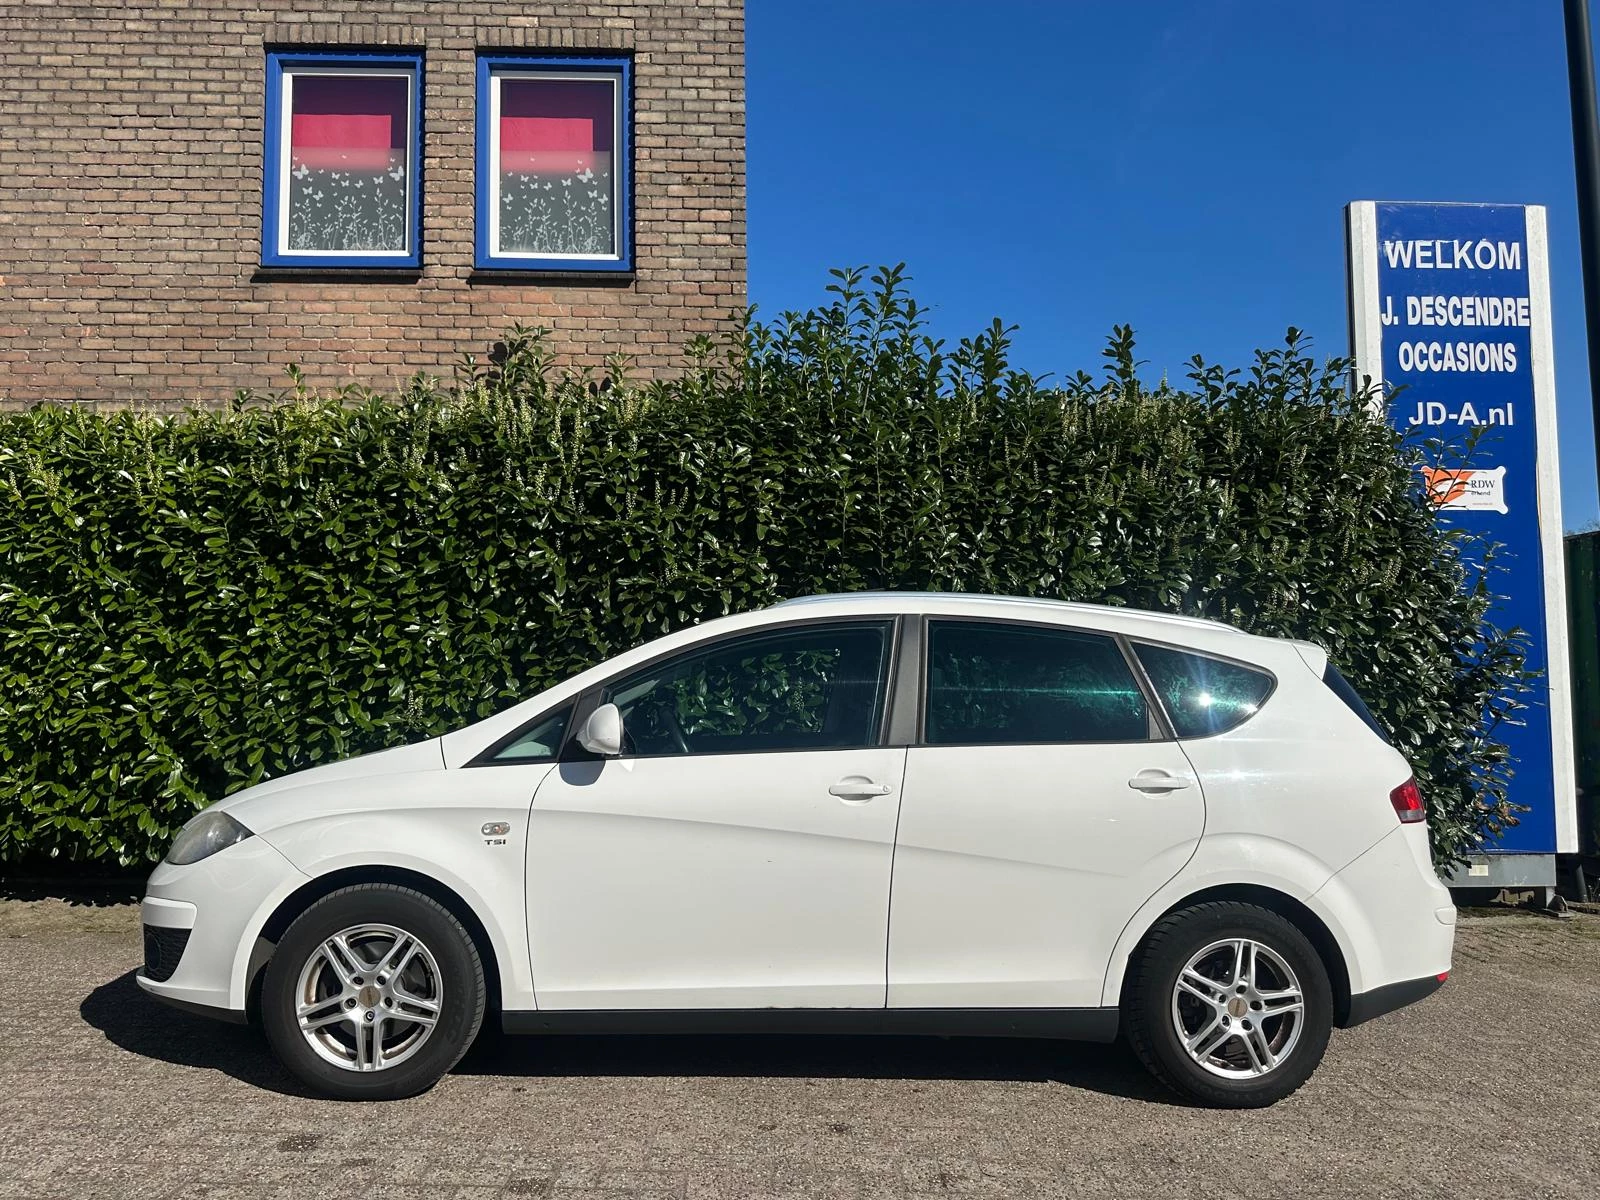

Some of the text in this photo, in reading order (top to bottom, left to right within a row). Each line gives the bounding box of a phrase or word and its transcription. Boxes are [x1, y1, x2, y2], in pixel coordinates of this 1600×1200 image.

[1385, 240, 1521, 270] WELKOM
[1381, 297, 1530, 326] J. DESCENDRE
[1399, 342, 1517, 372] OCCASIONS
[1408, 402, 1514, 425] JD-A.nl
[1471, 480, 1495, 488] RDW
